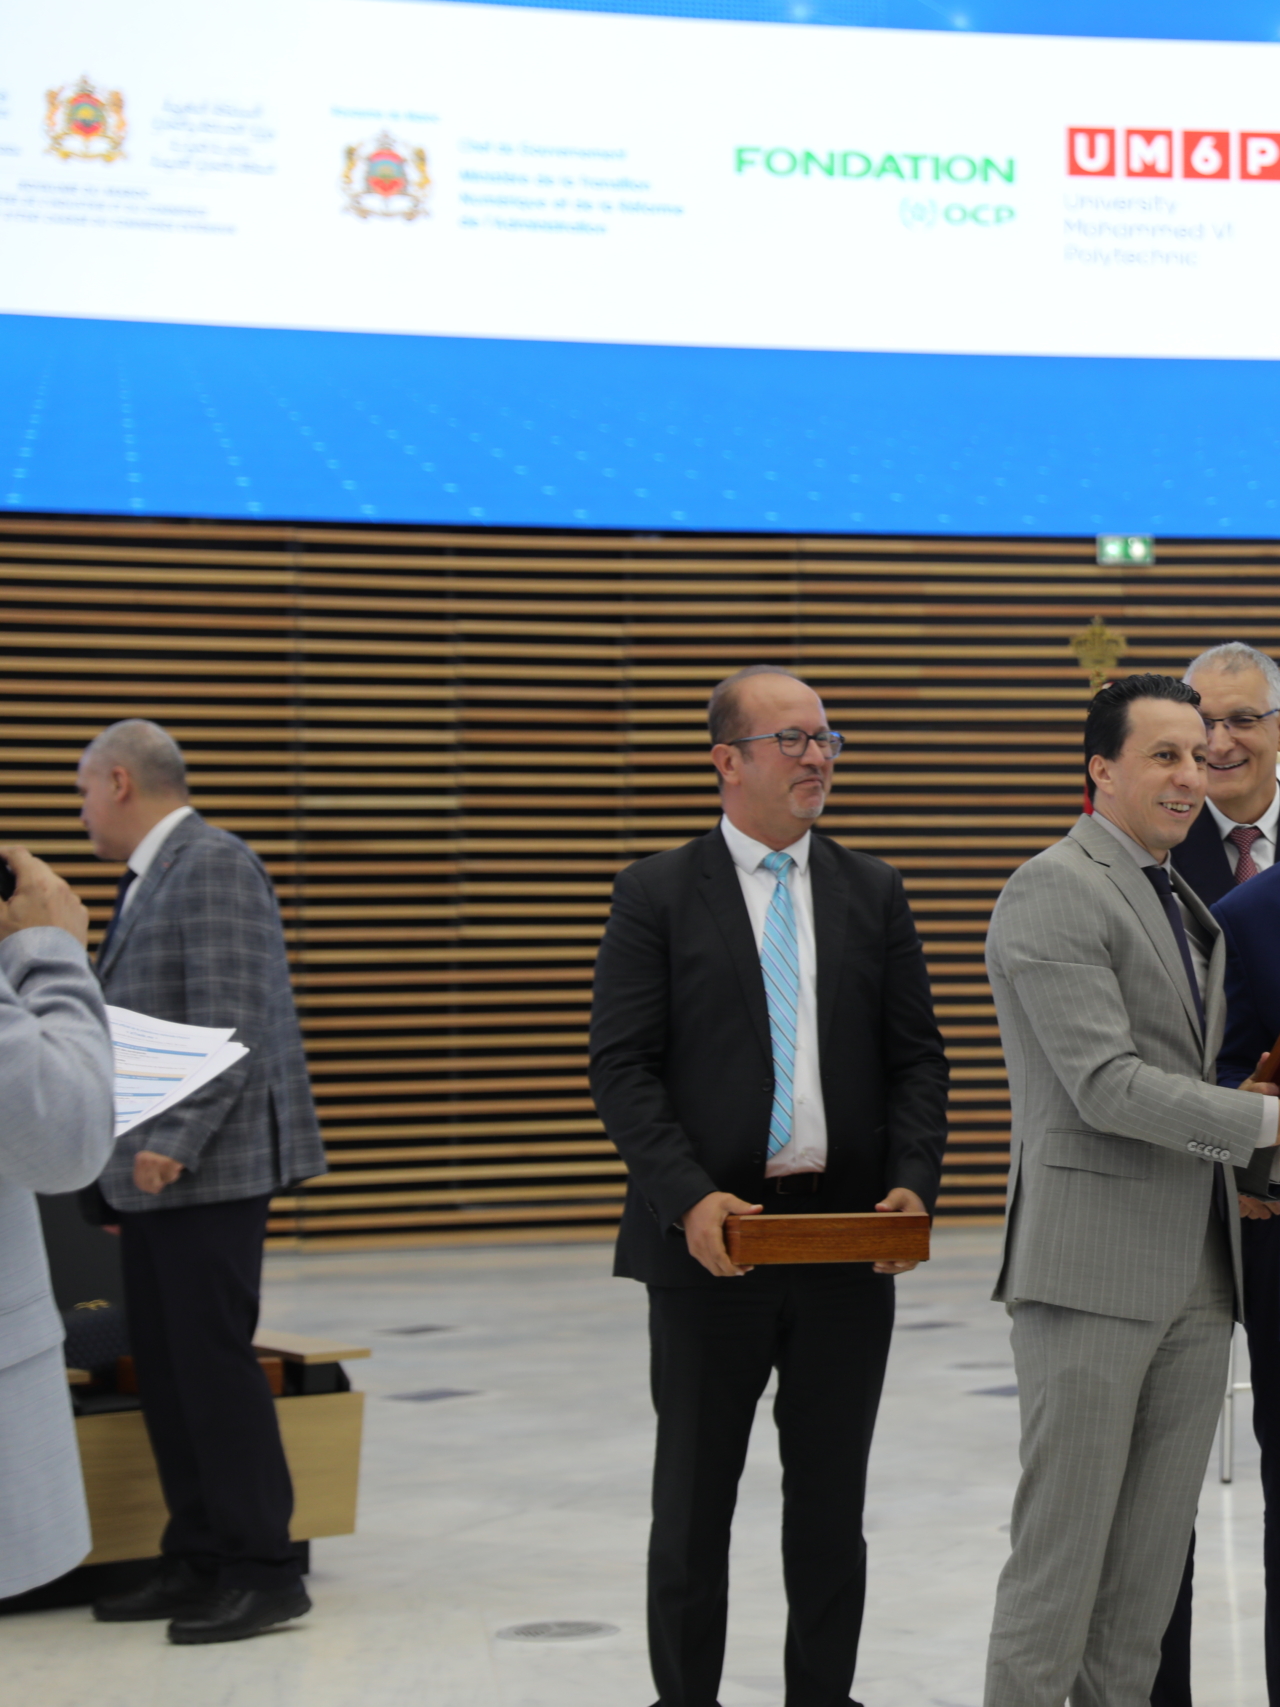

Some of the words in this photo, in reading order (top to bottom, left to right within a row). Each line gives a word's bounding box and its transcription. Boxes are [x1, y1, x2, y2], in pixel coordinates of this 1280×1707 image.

[733, 145, 1017, 185] FONDATION
[1073, 131, 1280, 177] UM6P
[942, 202, 1017, 227] OCP
[1062, 192, 1178, 215] University
[1062, 217, 1206, 241] Mohammed
[1062, 243, 1200, 267] Polytechnic
